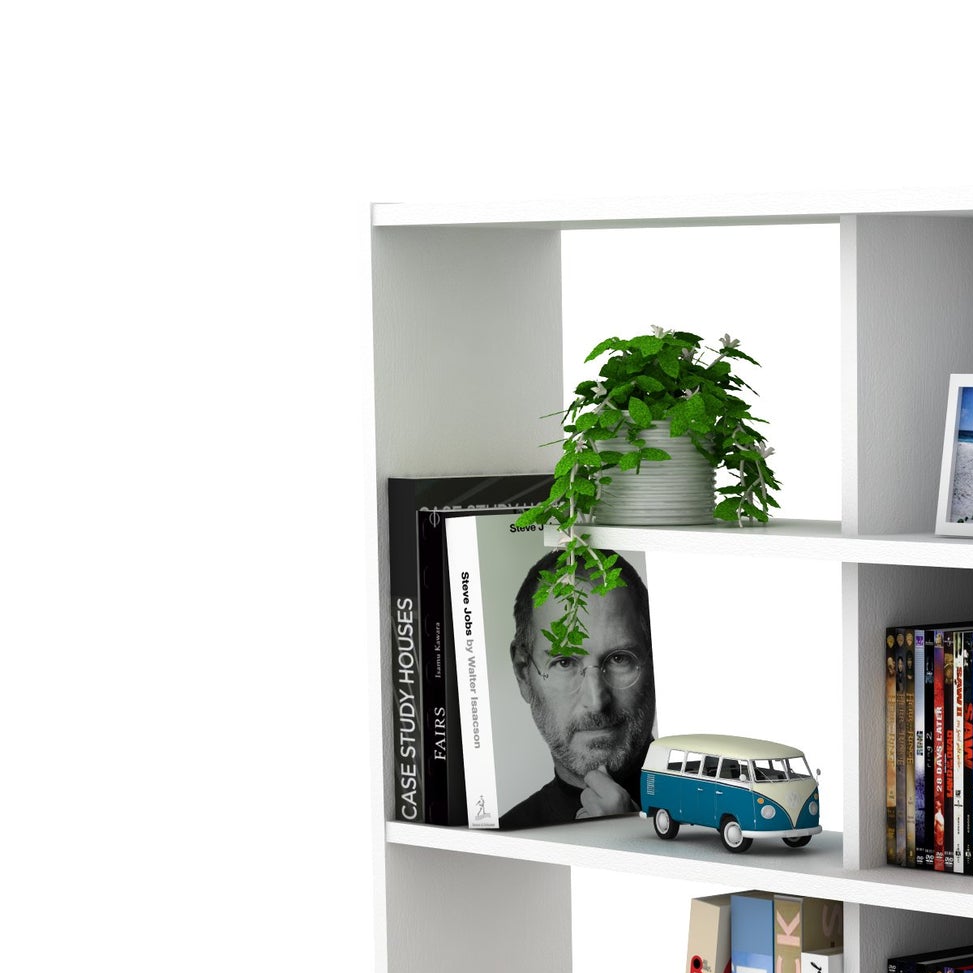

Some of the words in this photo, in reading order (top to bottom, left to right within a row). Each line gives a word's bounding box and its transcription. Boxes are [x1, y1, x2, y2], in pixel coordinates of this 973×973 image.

[460, 571, 470, 604] Steve
[397, 598, 415, 684] HOUSES
[464, 607, 473, 636] Jobs
[465, 639, 474, 652] by
[468, 656, 477, 693] Walter
[399, 688, 417, 759] STUDY
[434, 707, 447, 760] FAIRS
[471, 697, 481, 748] Isaacson
[946, 730, 954, 758] DEAD
[964, 703, 973, 769] SAW
[401, 763, 418, 820] CASE
[936, 777, 943, 792] 28
